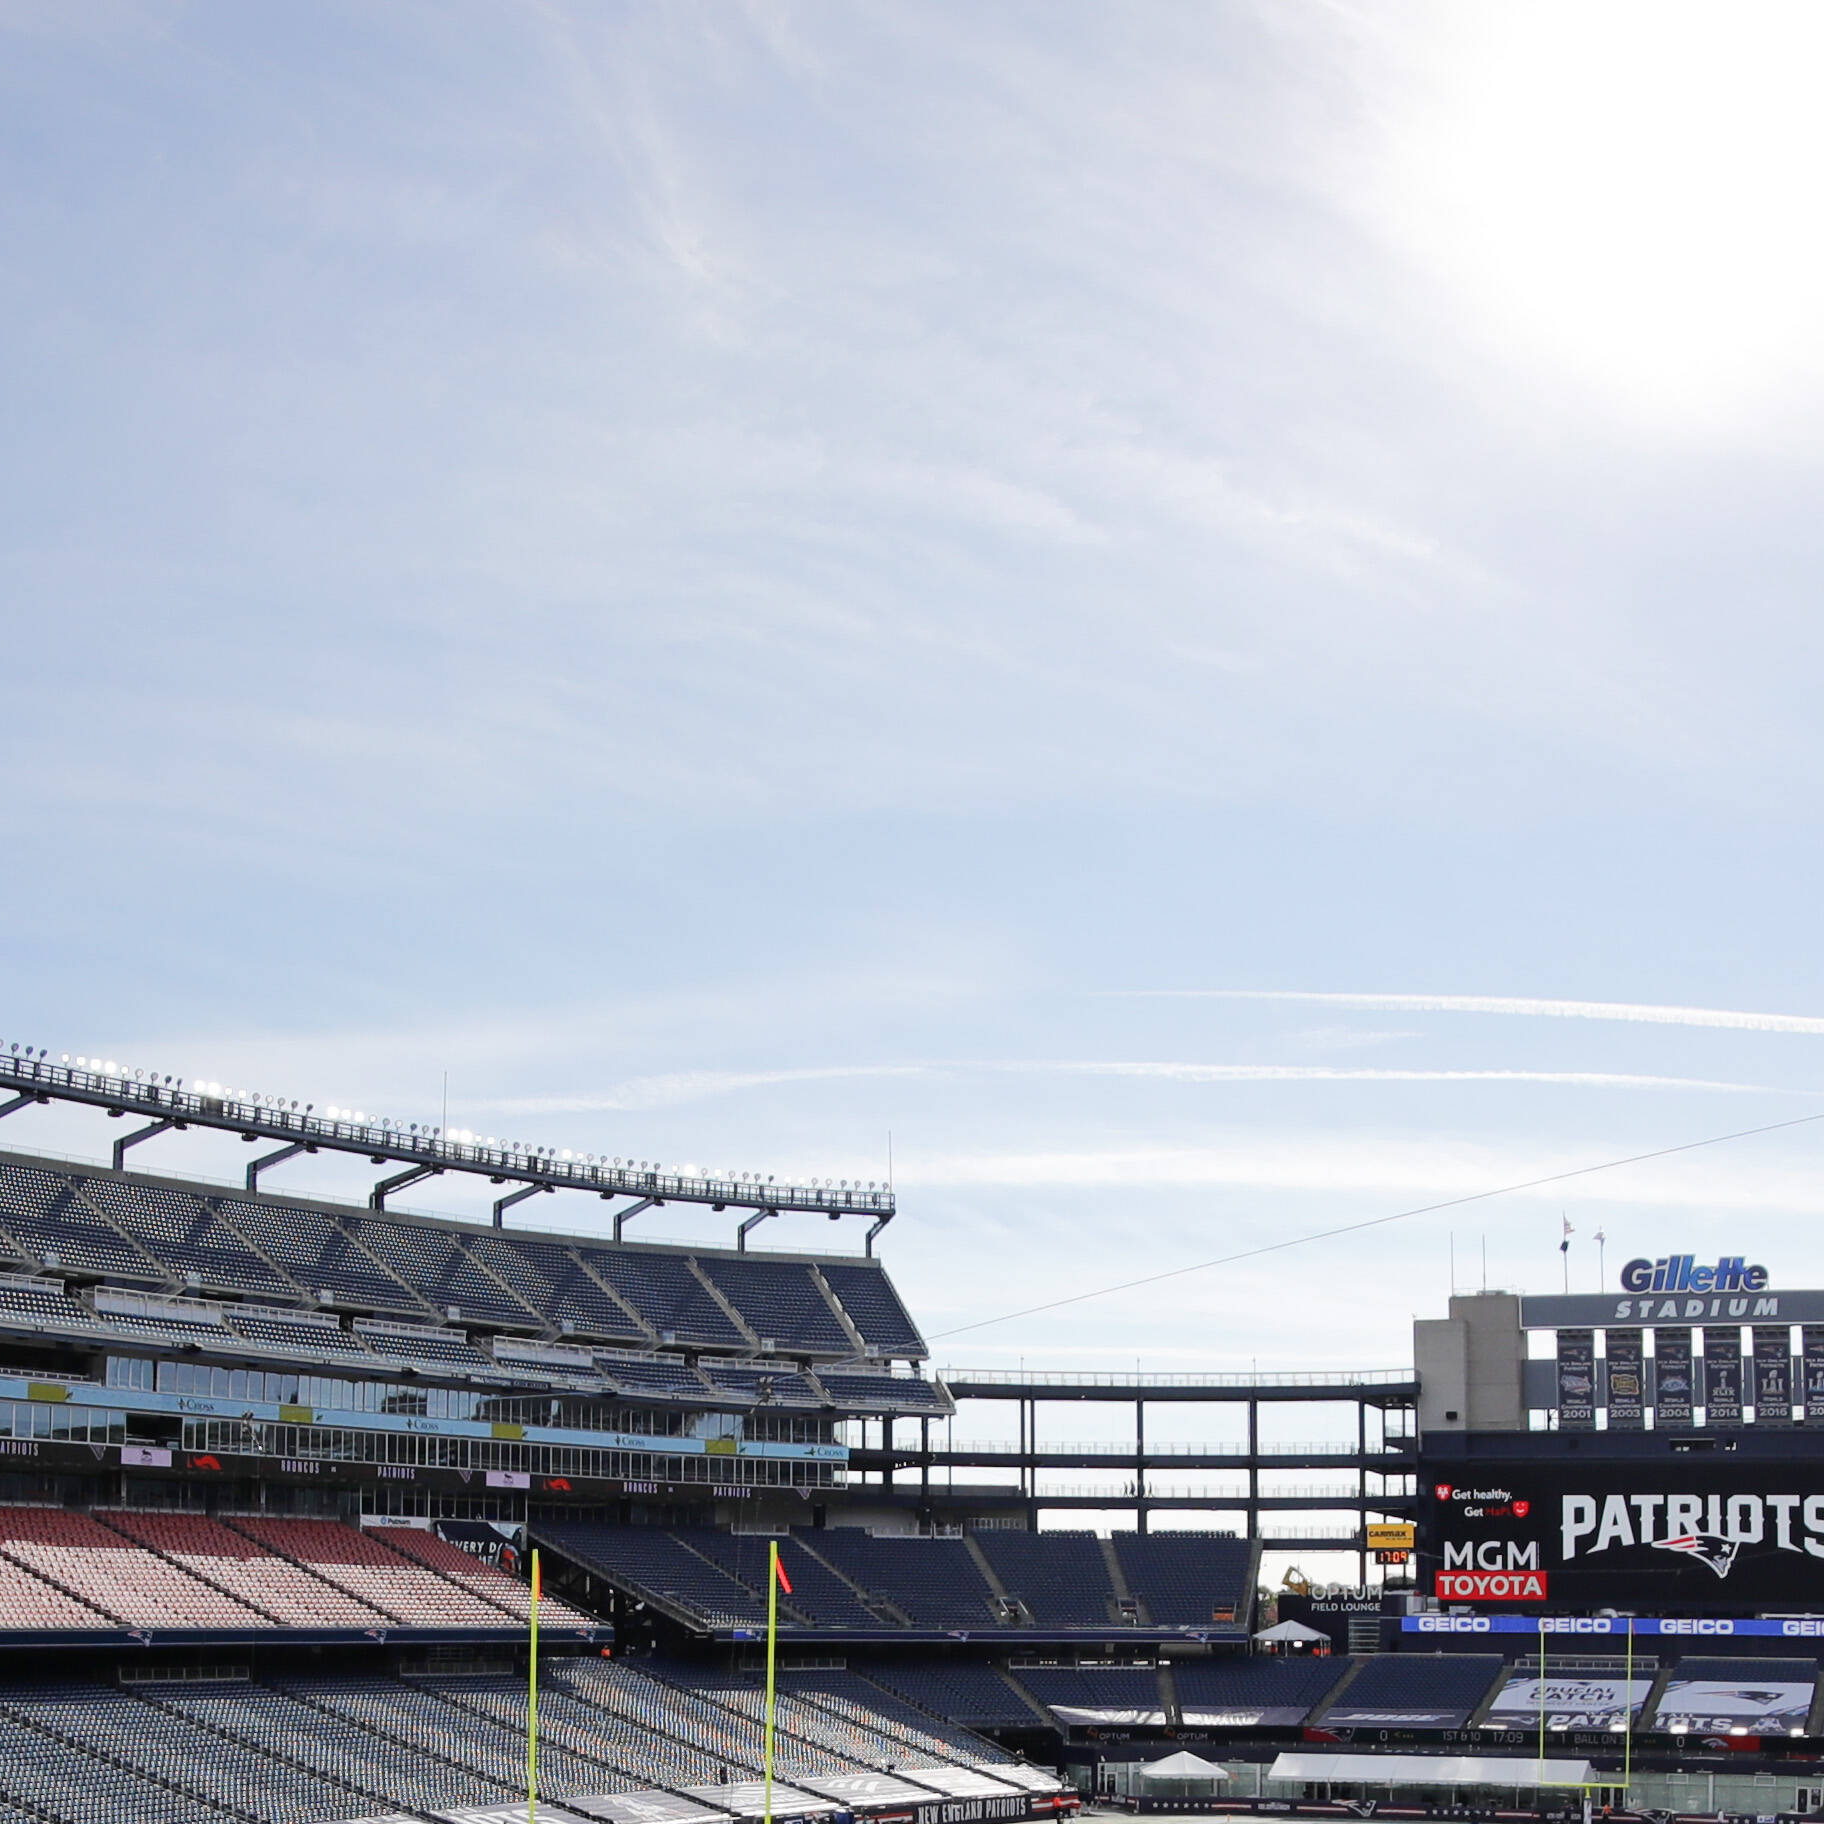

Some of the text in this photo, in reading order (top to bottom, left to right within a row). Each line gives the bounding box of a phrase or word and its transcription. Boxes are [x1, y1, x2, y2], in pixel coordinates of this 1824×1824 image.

[1621, 1254, 1768, 1294] Gillette
[1615, 1299, 1778, 1318] STADIUM
[1563, 1410, 1591, 1419] 2001
[1610, 1409, 1641, 1418] 2003
[1659, 1408, 1690, 1418] 2004
[1710, 1408, 1738, 1418] 2014
[1452, 1489, 1512, 1502] Get healthy.
[1464, 1506, 1484, 1517] Get
[1444, 1541, 1537, 1571] MGM
[1439, 1575, 1542, 1595] TOYOTA
[1311, 1584, 1383, 1601] OPTUM
[1311, 1602, 1382, 1612] FIELD LOUNGE
[1418, 1617, 1490, 1632] GEICO
[1538, 1618, 1611, 1633] GEICO
[1659, 1619, 1734, 1635] GEICO
[1530, 1692, 1614, 1701] CATCH
[1098, 1732, 1130, 1741] OPTUM
[1176, 1732, 1209, 1741] OPTUM
[1470, 1731, 1481, 1742] 10
[942, 1801, 982, 1824] ENGLAND
[985, 1797, 1026, 1819] PATRIOTS
